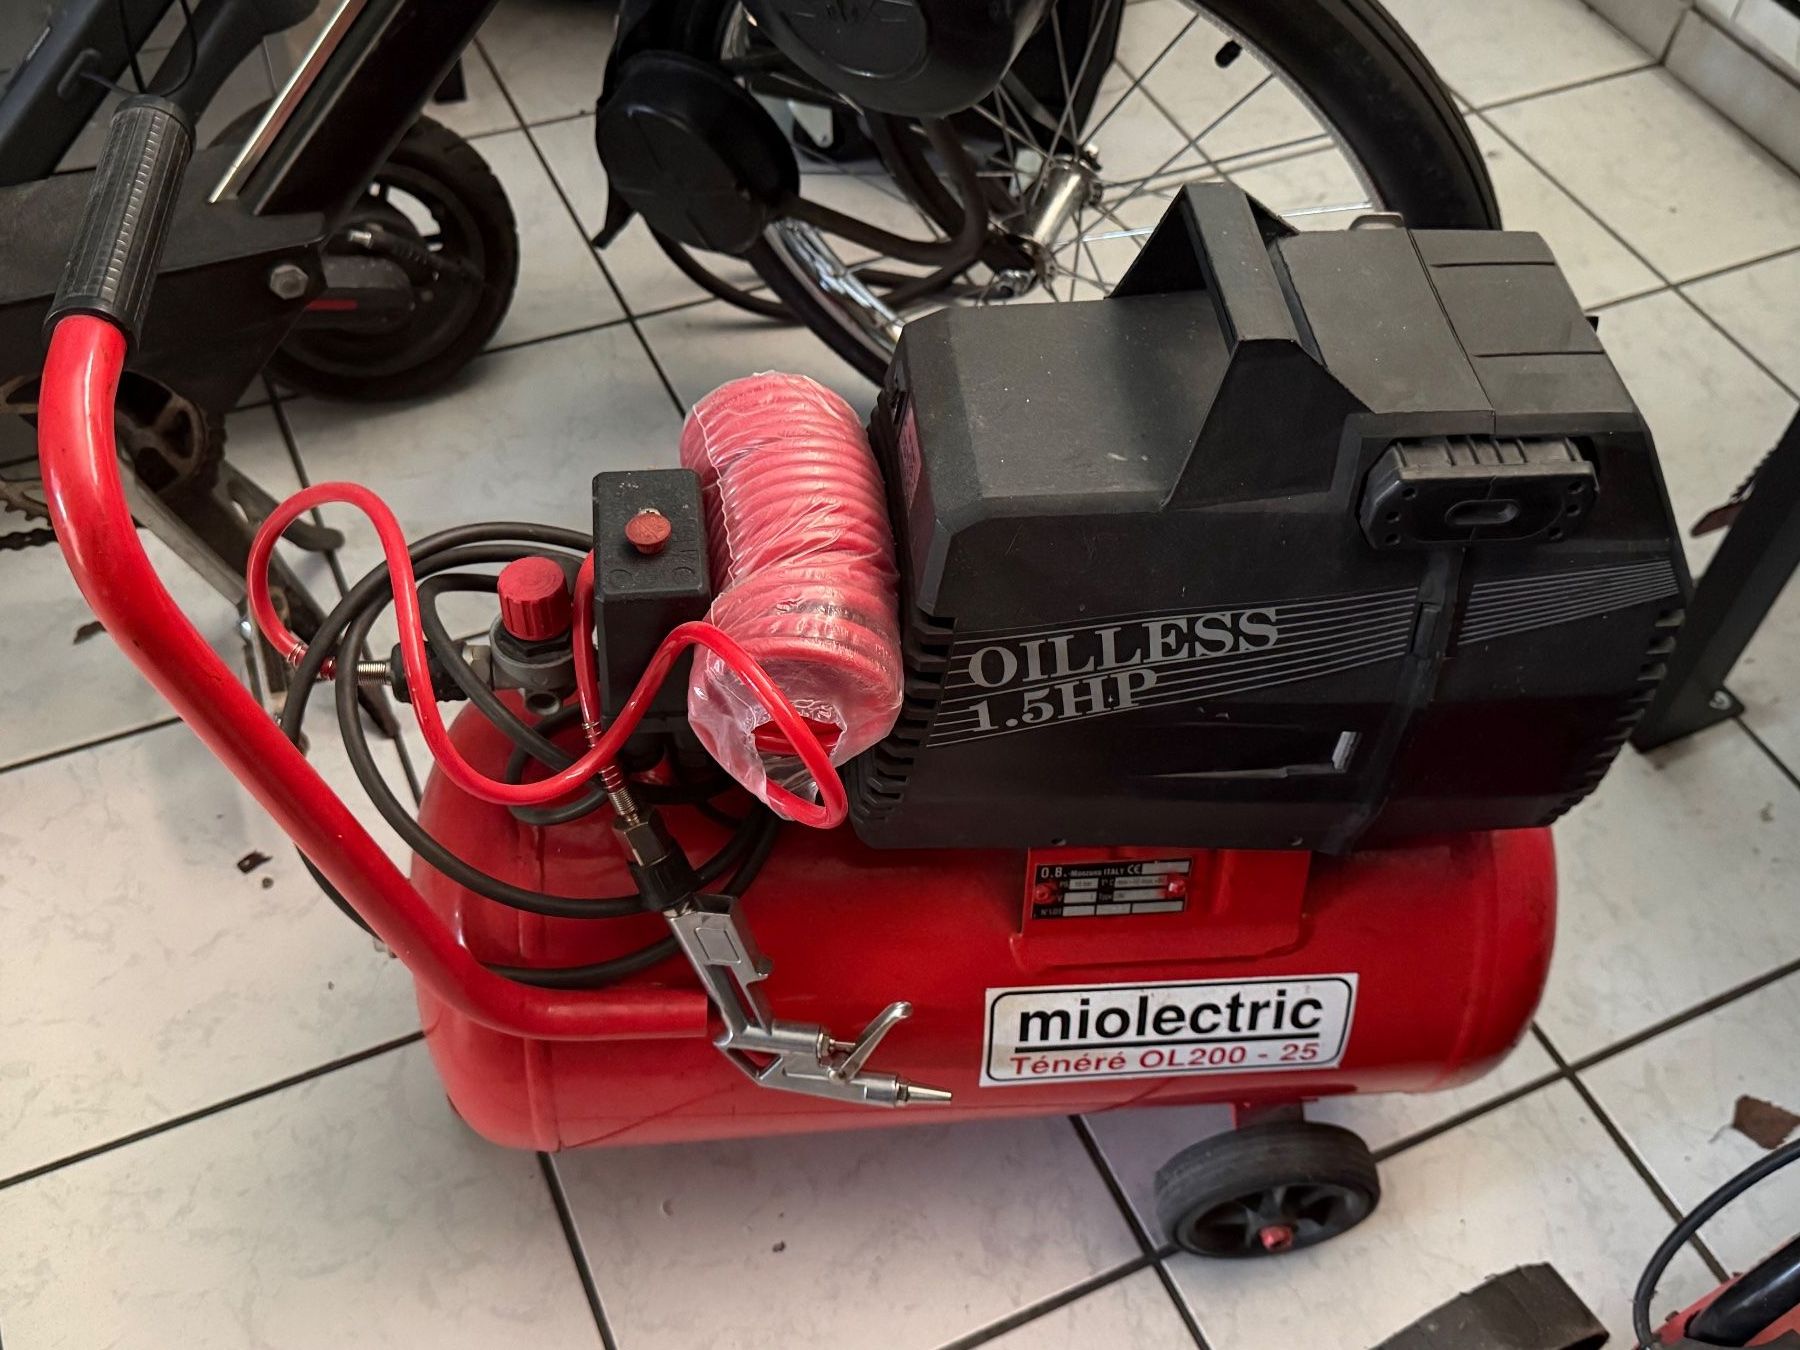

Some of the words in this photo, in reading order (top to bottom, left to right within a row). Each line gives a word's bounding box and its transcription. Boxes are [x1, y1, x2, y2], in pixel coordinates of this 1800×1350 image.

[967, 607, 1280, 689] OILLESS
[968, 667, 1159, 733] 1.5HP
[1018, 989, 1323, 1043] miolectric
[1010, 1054, 1127, 1076] Ténéré
[1138, 1046, 1247, 1070] OL200
[1279, 1042, 1321, 1062] 25
